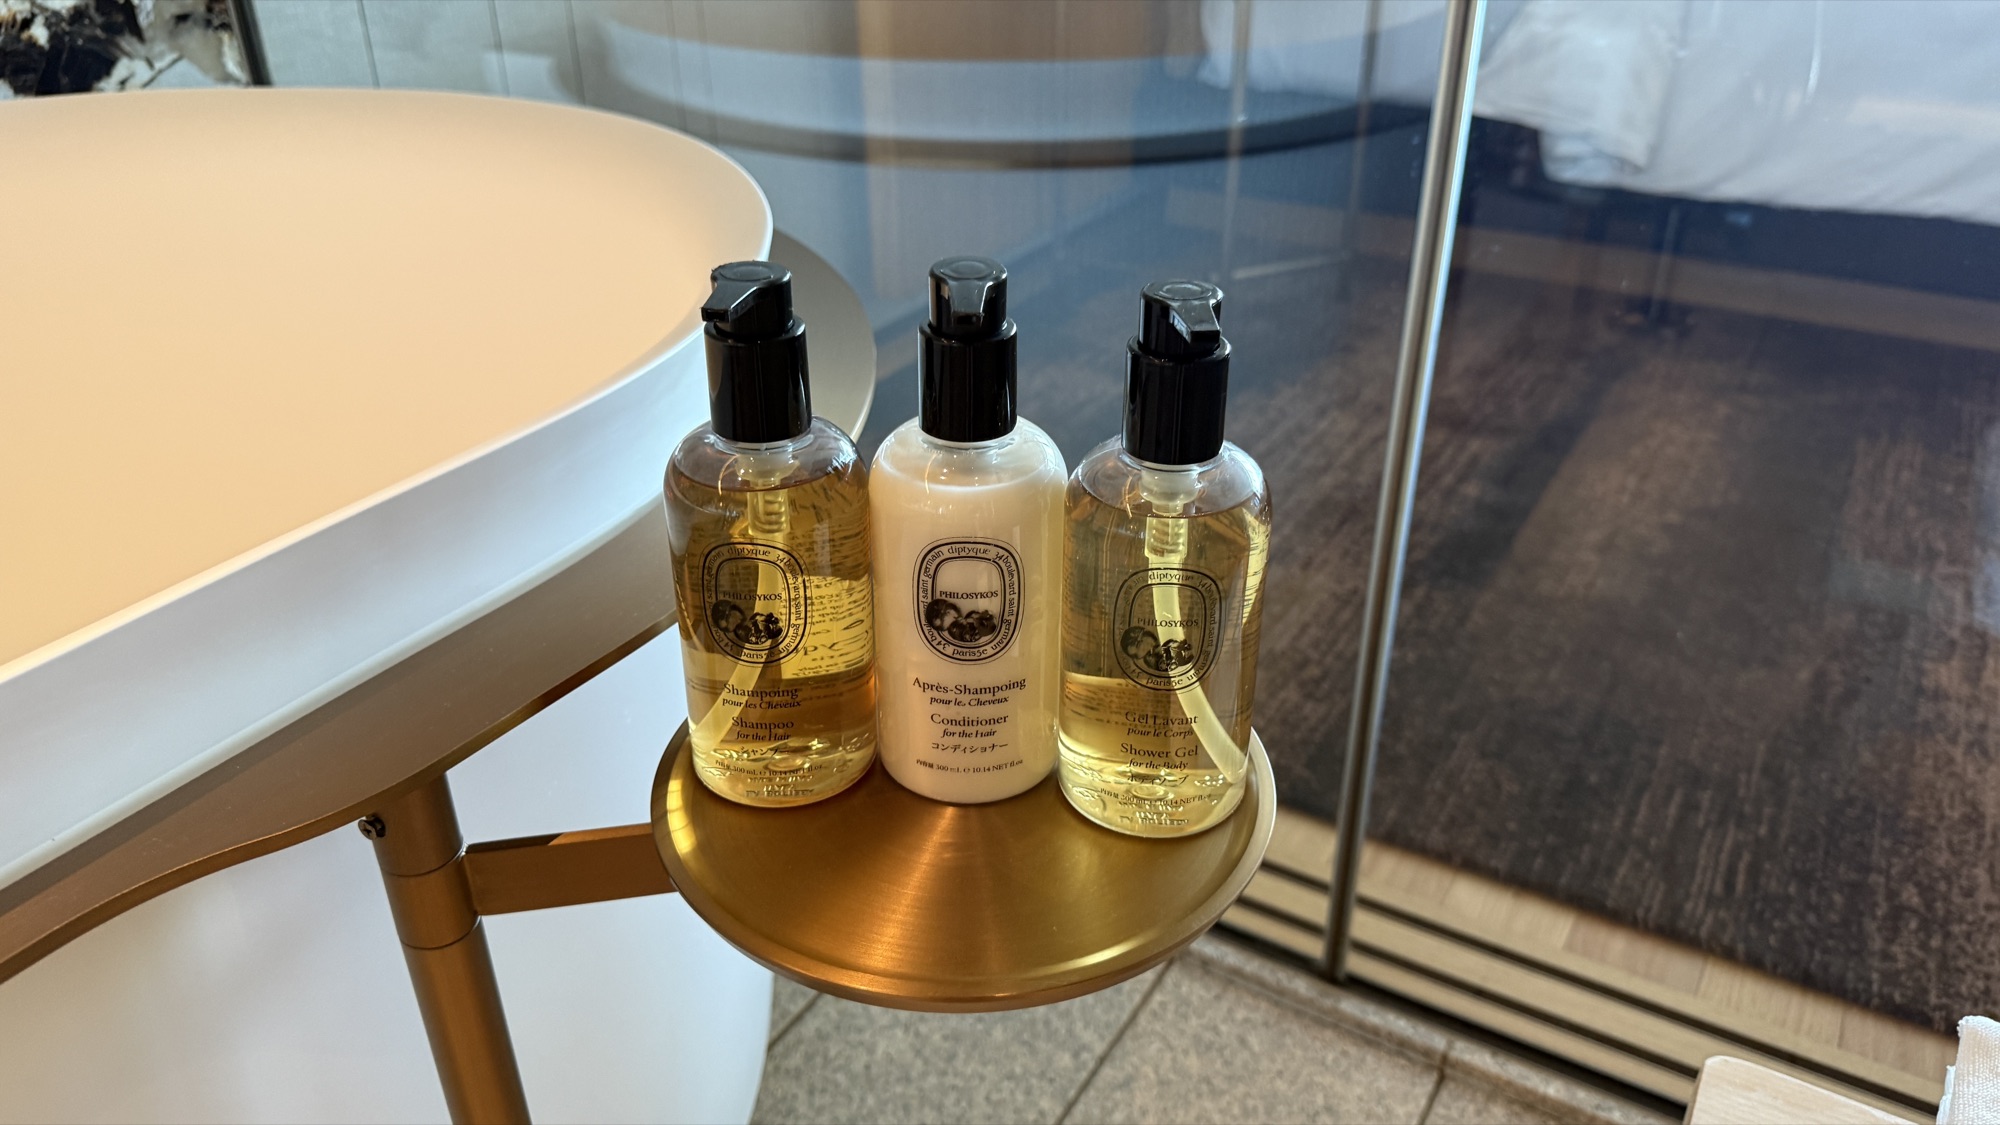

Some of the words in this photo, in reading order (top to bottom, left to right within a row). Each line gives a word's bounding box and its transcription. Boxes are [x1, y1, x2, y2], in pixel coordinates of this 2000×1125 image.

[947, 546, 991, 555] diptyque
[922, 550, 944, 579] germain
[1003, 556, 1016, 596] boulevard
[1149, 572, 1194, 582] diptyque
[727, 546, 771, 557] diptyque
[794, 600, 802, 622] saint
[920, 579, 929, 600] saint
[722, 592, 783, 601] PHILOSYKOS
[939, 590, 999, 599] PHILOSYKOS
[1008, 598, 1016, 616] saint
[1137, 617, 1199, 627] PHILOSYKOS
[991, 618, 1012, 650] germain
[936, 640, 950, 650] 34
[723, 684, 799, 699] Shampoing
[912, 677, 1027, 696] Après-Shampoing
[722, 698, 744, 708] pour
[745, 699, 758, 708] les
[759, 699, 802, 709] Cheveux
[930, 696, 952, 705] pour
[968, 696, 1009, 706] Cheveux
[731, 716, 794, 731] Shampoo
[930, 713, 1009, 727] Conditioner
[1124, 711, 1149, 724] Gel
[1153, 715, 1198, 726] Lavant
[736, 731, 751, 740] for
[751, 732, 765, 741] the
[768, 731, 791, 741] Hair
[940, 728, 956, 738] for
[958, 729, 973, 738] the
[974, 728, 997, 738] Hair
[1126, 727, 1152, 737] pour
[1153, 728, 1163, 738] le
[1164, 729, 1193, 739] Corps
[931, 742, 1008, 754] コンディショナー
[1120, 742, 1171, 758] Shower
[1174, 745, 1198, 757] Gel
[1128, 759, 1144, 768] for
[1145, 760, 1161, 769] the
[1163, 761, 1188, 771] Body
